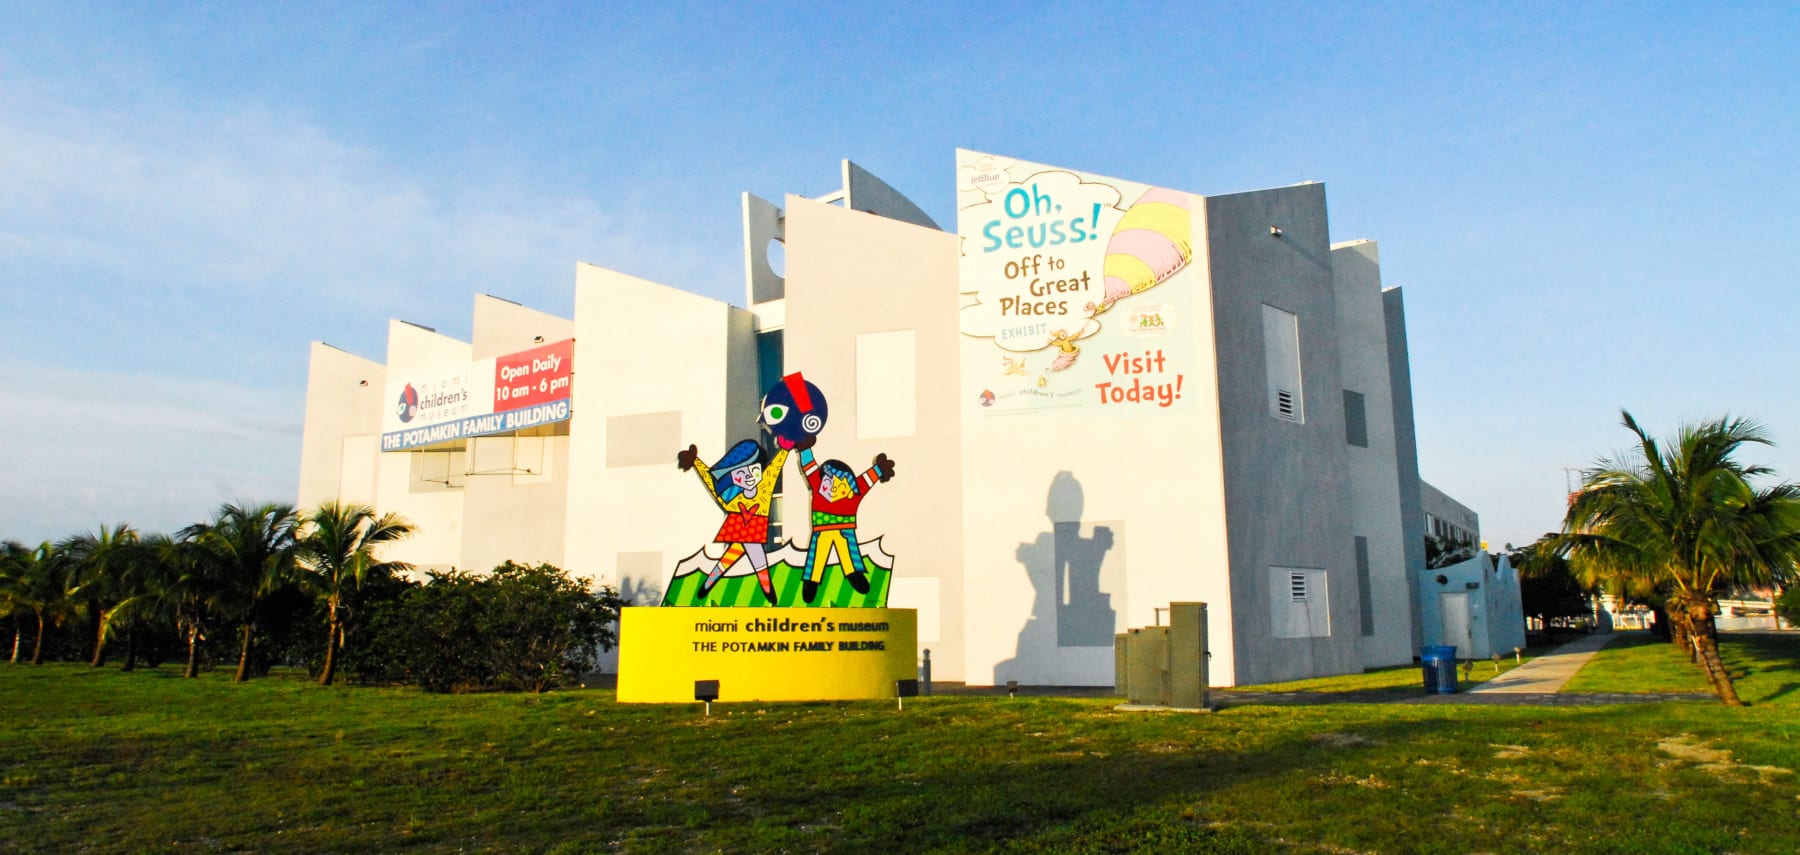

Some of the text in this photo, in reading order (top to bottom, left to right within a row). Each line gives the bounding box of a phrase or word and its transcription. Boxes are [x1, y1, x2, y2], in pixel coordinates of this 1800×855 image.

[971, 173, 1000, 185] jetBlue
[1004, 183, 1062, 219] Oh,
[982, 202, 1102, 253] Seuss!
[1004, 254, 1065, 280] Off to
[1029, 270, 1091, 297] Great
[1000, 295, 1068, 316] Places
[1002, 322, 1048, 340] EXHIBIT
[501, 354, 561, 382] Open Daily
[1103, 349, 1166, 376] Visit
[419, 388, 468, 410] children's
[496, 387, 509, 401] 10
[512, 385, 529, 398] am
[540, 377, 548, 393] 6
[550, 375, 569, 394] pm
[1095, 374, 1183, 408] Today!
[383, 401, 568, 449] THE POTAMKIN FAMILY BUILDING
[694, 617, 890, 632] miami children's museum
[692, 640, 885, 652] THE POTAMKIN FAMILY BUILDING
